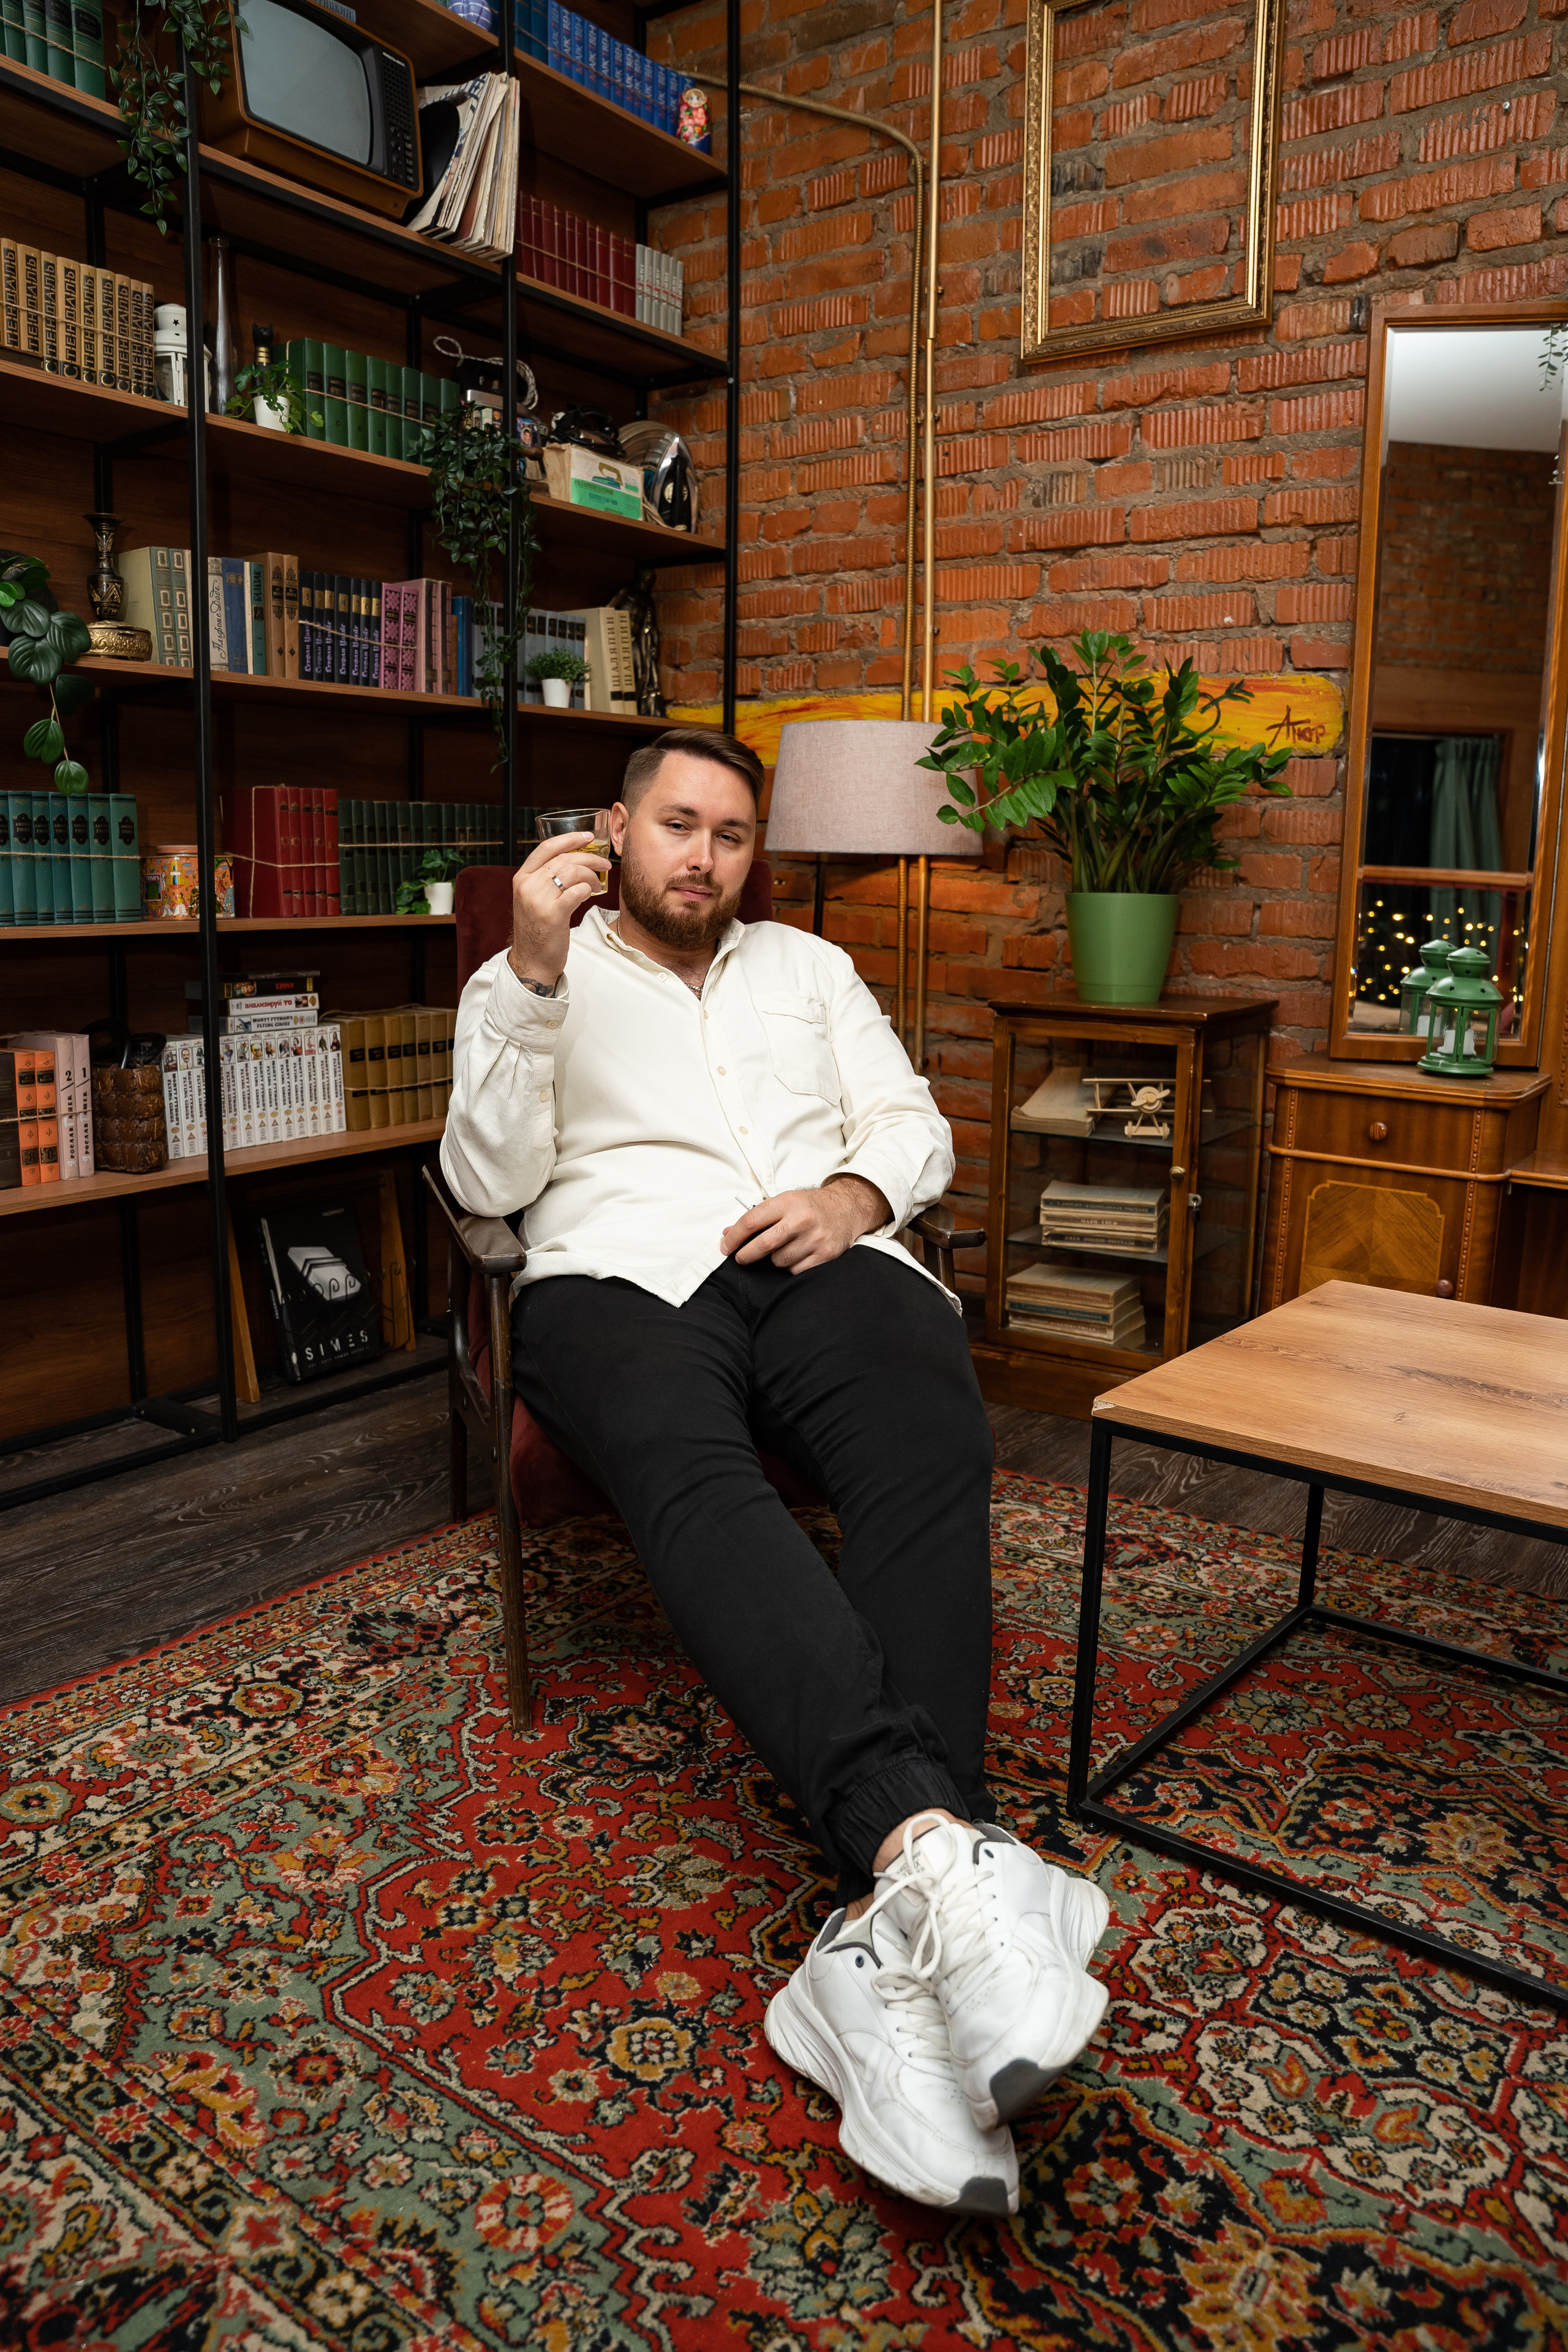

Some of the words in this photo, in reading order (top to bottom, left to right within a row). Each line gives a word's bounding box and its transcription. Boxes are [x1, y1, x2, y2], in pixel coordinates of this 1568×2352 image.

[6, 251, 18, 347] ТЕНДАЛЬ
[26, 257, 39, 352] ТЕНДАЛЬ
[45, 263, 58, 374] СТЕНДАЛЬ
[64, 271, 78, 379] СТЕНДАЛЬ
[83, 279, 96, 383] СТЕНДАЛЬ
[100, 282, 115, 387] СТЕНДАЛЬ
[116, 288, 130, 392] СТЕНДАЛЬ
[131, 293, 143, 396] СТЕНДАЛЬ
[143, 296, 153, 398] СТЕНДАЛЬ
[210, 580, 222, 613] Доде
[211, 614, 227, 660] Альфонс
[606, 617, 620, 687] ШАЛЯПИН
[619, 616, 633, 685] ШАЛЯПИН
[245, 999, 282, 1009] анализируй
[66, 1071, 72, 1082] 2
[81, 1067, 86, 1078] 1
[67, 1127, 77, 1167] ЯРОСЛАВ
[82, 1123, 92, 1163] ЯРОСЛАВ
[304, 1330, 369, 1361] SIMES
